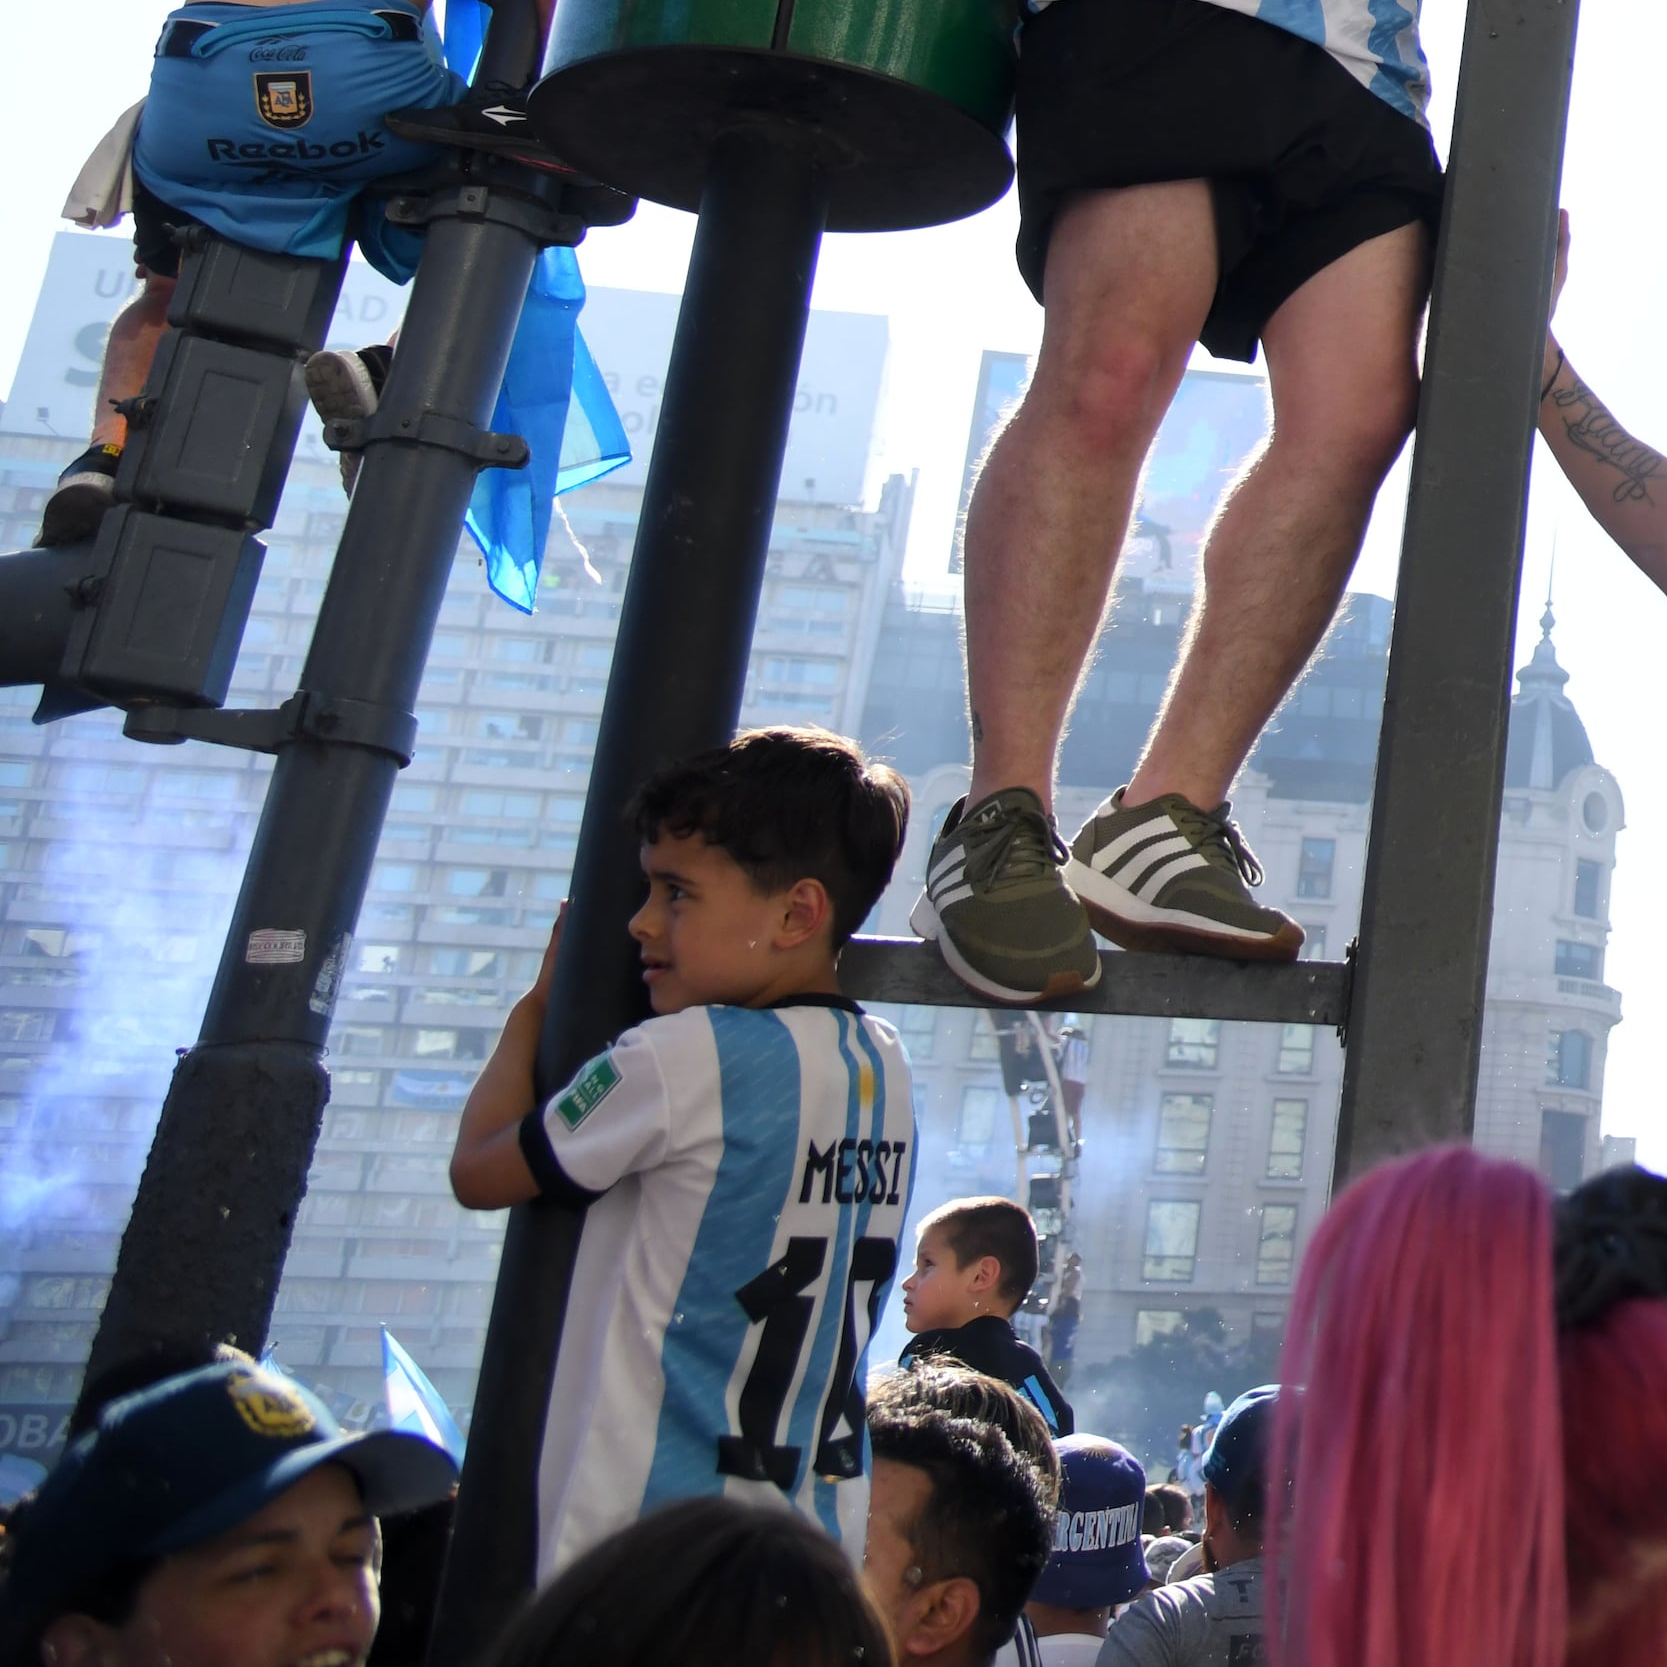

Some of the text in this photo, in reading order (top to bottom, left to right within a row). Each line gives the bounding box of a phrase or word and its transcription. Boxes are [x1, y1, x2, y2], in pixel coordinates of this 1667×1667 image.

[207, 131, 385, 161] Reebok
[799, 1137, 906, 1205] MESSI
[716, 1236, 898, 1491] 10
